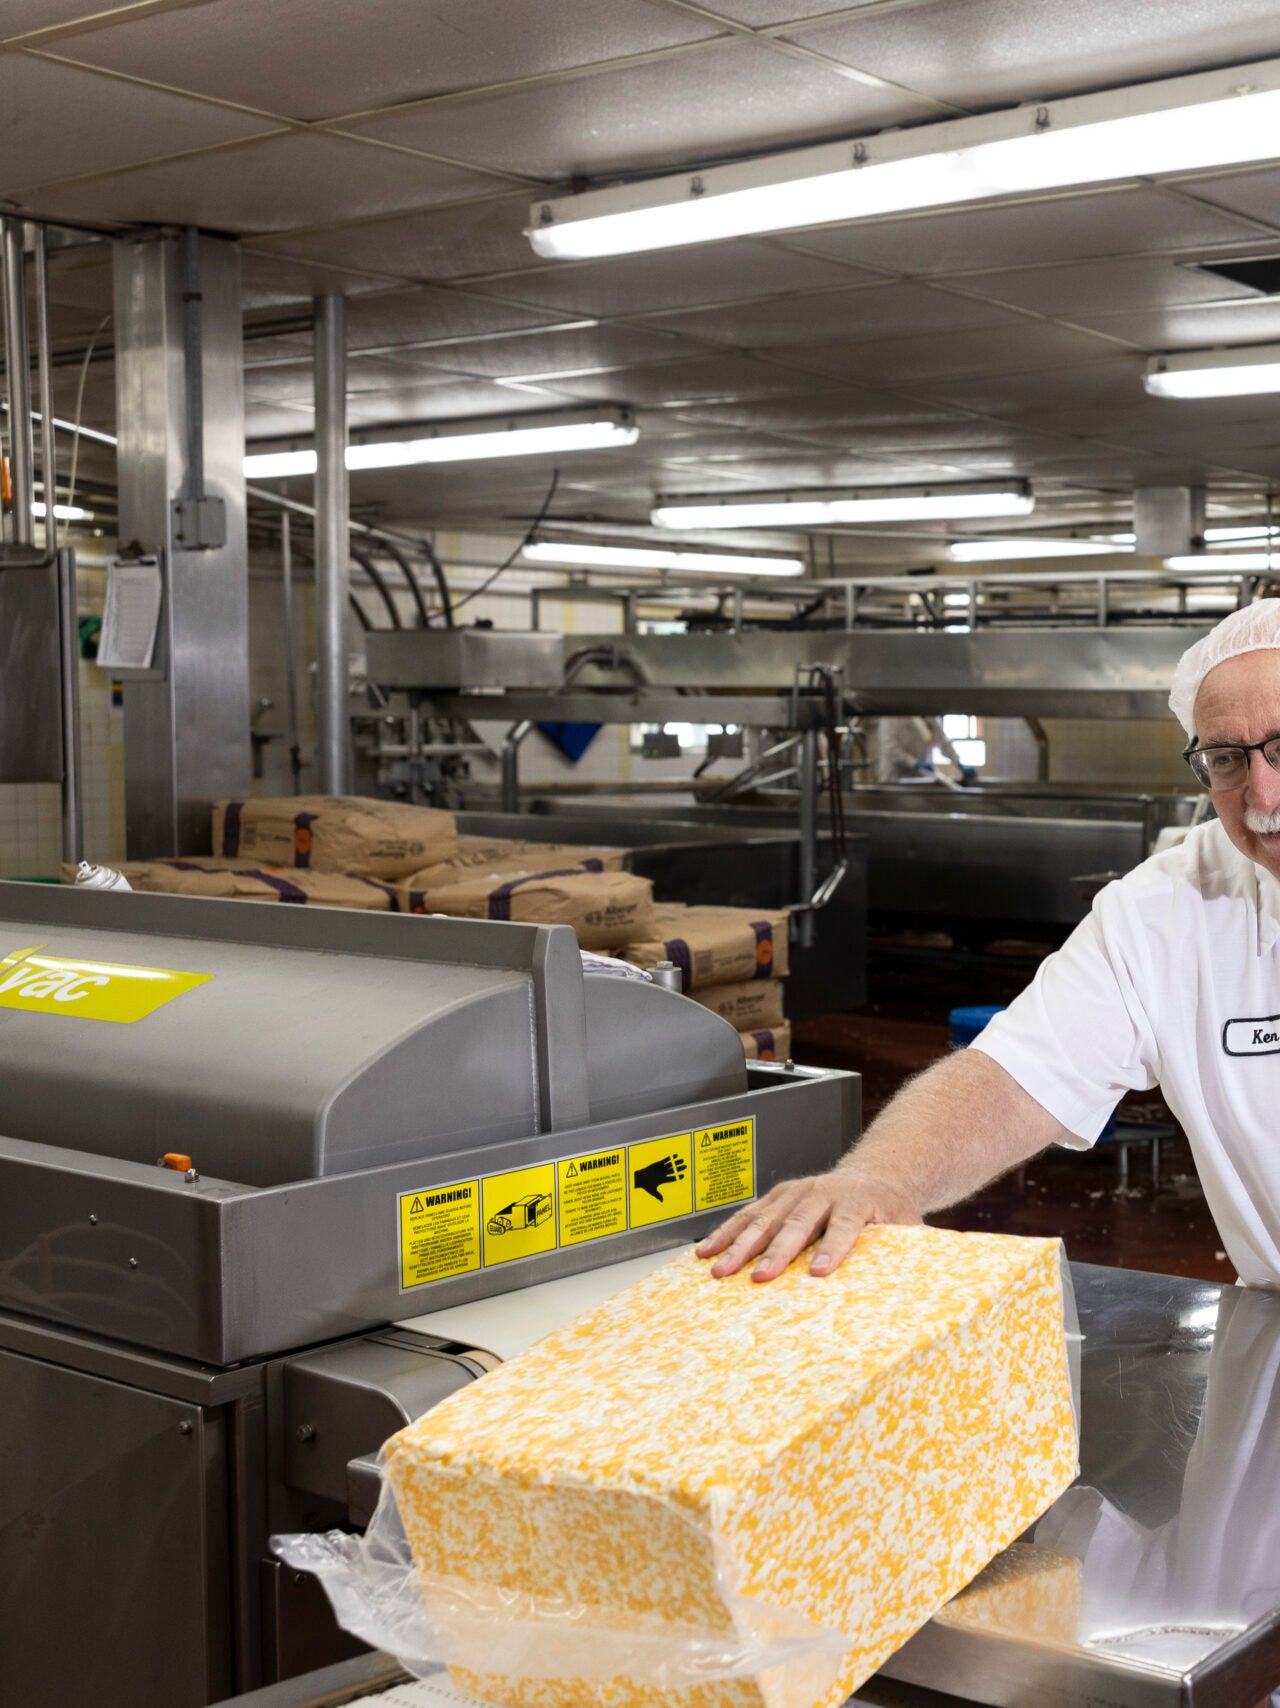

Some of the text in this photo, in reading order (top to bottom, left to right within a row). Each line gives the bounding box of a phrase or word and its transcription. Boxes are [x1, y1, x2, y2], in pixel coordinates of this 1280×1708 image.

[1252, 1029, 1280, 1044] Ken
[713, 1126, 747, 1141] WARNING!
[580, 1154, 619, 1172] WARNING!
[426, 1188, 471, 1207] WARNING!
[537, 1204, 551, 1217] PANEL
[490, 1225, 502, 1234] GUARD
